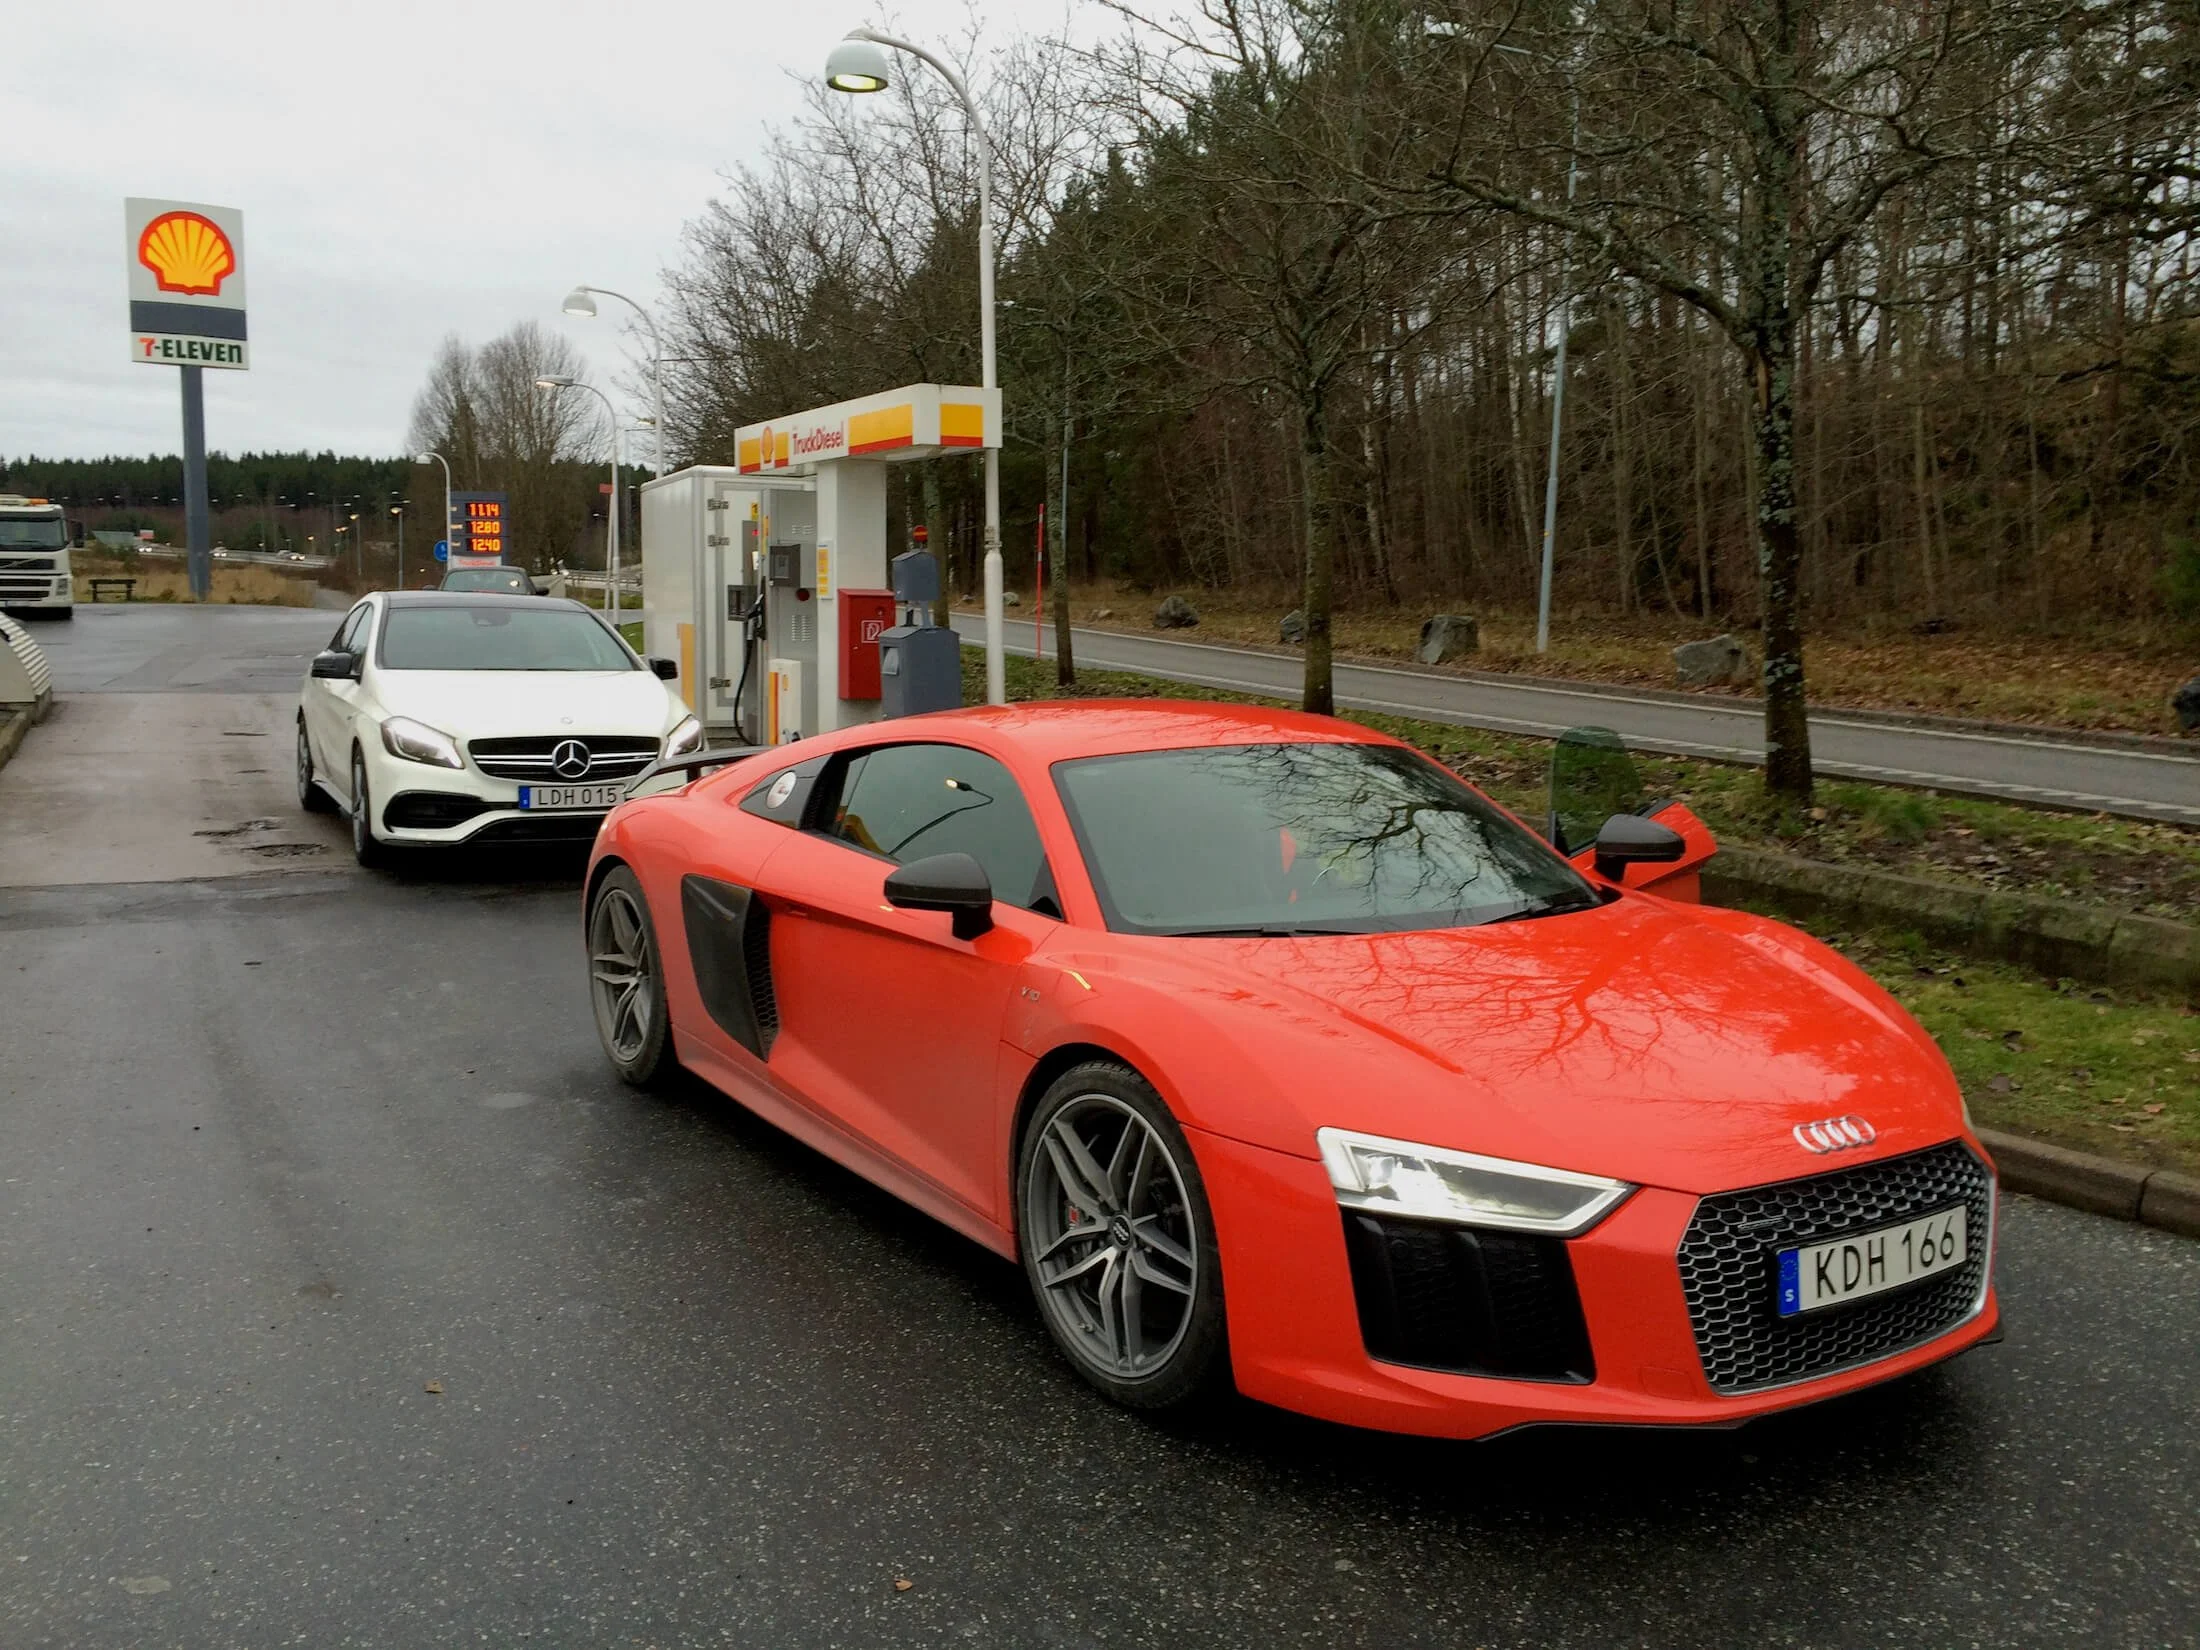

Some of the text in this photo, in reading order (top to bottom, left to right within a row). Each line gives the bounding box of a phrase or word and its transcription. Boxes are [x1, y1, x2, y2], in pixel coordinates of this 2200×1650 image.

[538, 787, 617, 805] LDH 015
[1815, 1215, 1955, 1298] KDH 166
[1785, 1288, 1794, 1302] S
